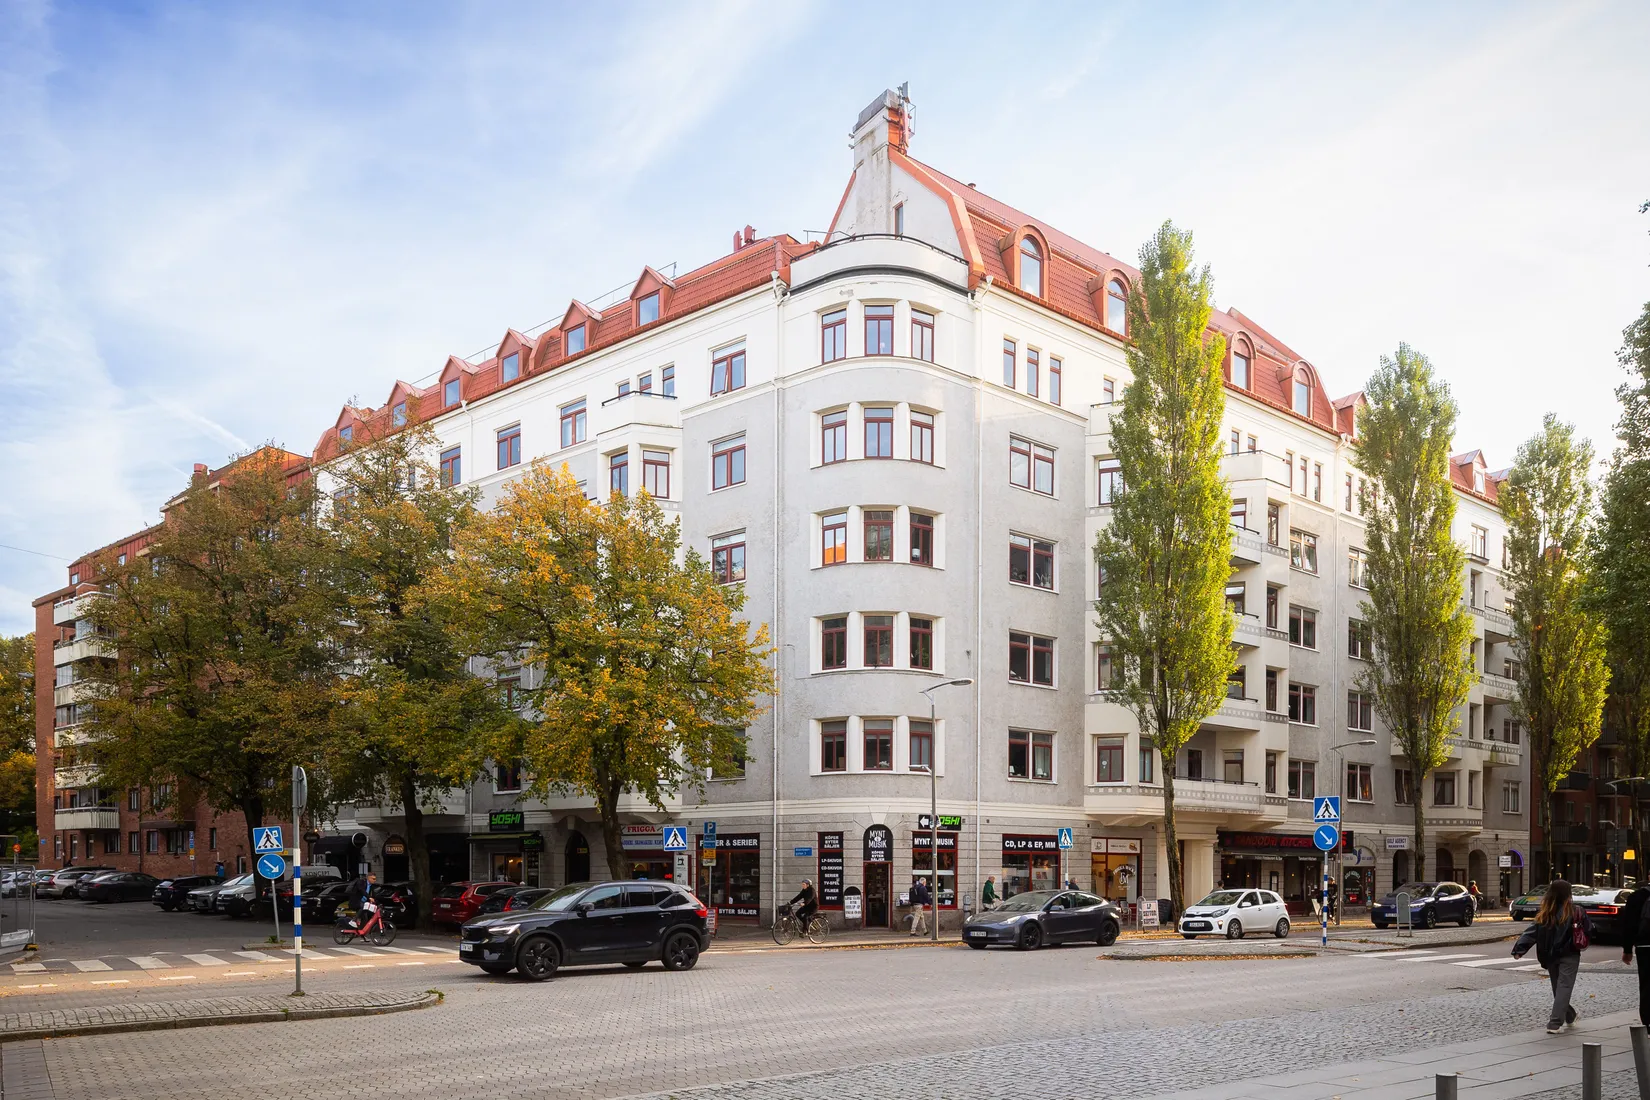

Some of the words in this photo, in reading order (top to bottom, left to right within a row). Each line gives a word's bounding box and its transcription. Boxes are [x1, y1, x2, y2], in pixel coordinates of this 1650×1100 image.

[491, 813, 521, 824] YOSHI
[939, 816, 960, 825] OSHI
[627, 825, 655, 833] FRIGGA
[870, 830, 885, 839] MYNT
[869, 840, 887, 848] MUSIK
[936, 838, 954, 846] MUSIK
[1005, 841, 1016, 849] CD,
[1280, 837, 1313, 847] KITCHEN
